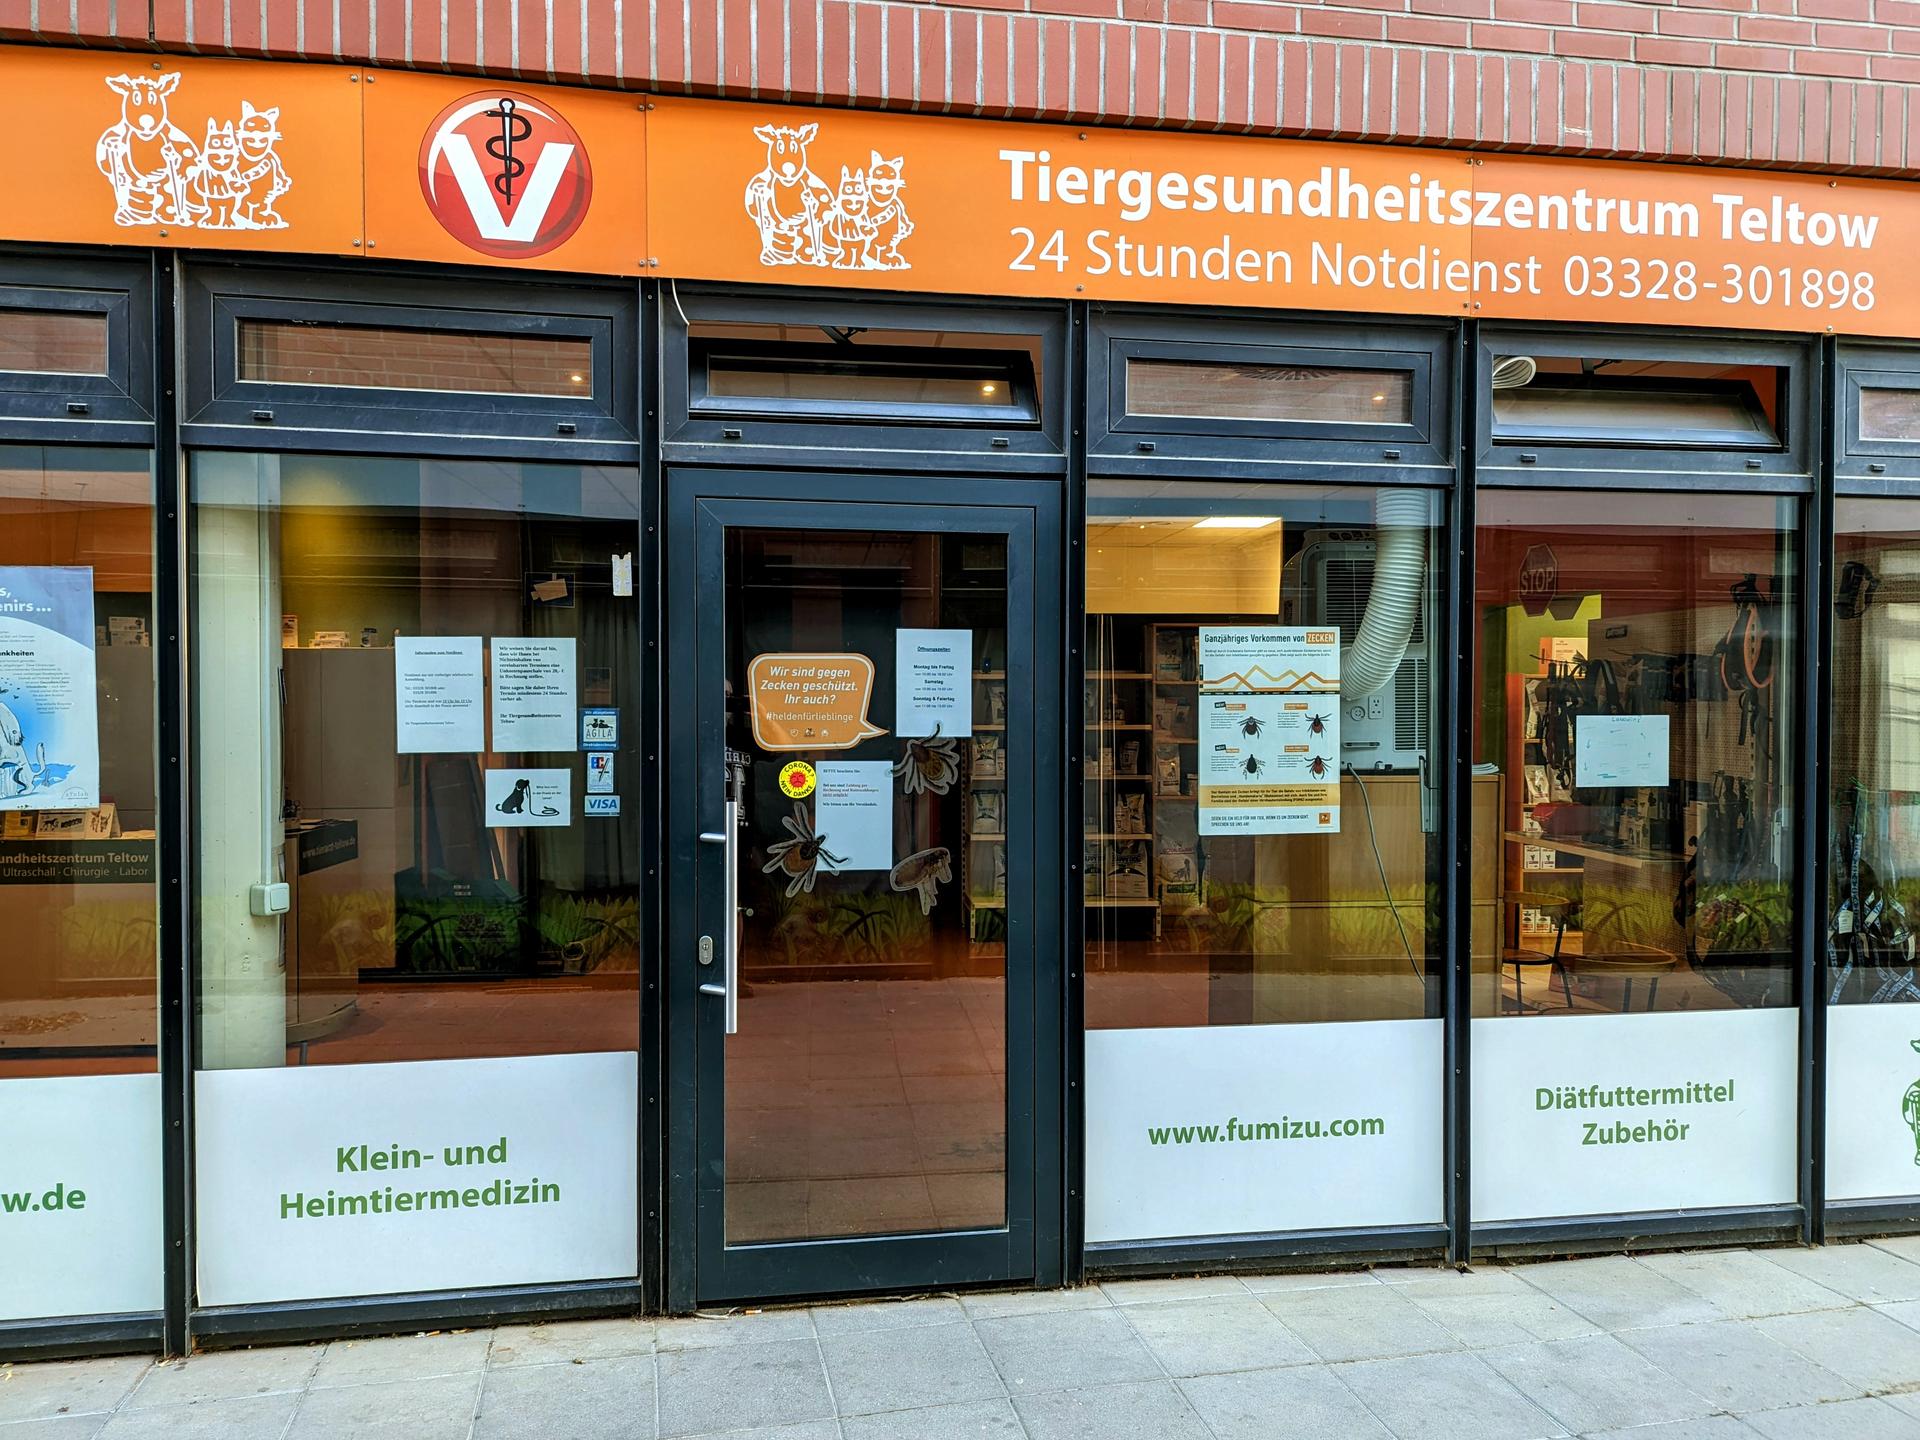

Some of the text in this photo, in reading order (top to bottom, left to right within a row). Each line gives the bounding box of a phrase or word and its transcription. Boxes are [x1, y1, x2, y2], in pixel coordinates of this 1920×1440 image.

[999, 149, 1879, 249] Tiergesundheitszentrum Teltow
[1008, 226, 1876, 312] 24 Stunden Notdienst 03328-301898
[1520, 565, 1554, 593] STOP
[1204, 634, 1248, 646] Ganzjähriges
[1251, 634, 1291, 643] Vorkommen
[1307, 634, 1334, 643] ZECKEN
[0, 649, 35, 657] nkheiten
[770, 666, 850, 679] Wir sind gegen
[760, 680, 858, 692] Zecken geschützt.
[784, 694, 836, 704] Ihr auch?
[766, 711, 854, 722] #heldenfürlieblinge
[586, 728, 612, 738] AGILA
[780, 780, 813, 797] NEIN DANKE
[589, 799, 618, 809] VISA
[107, 851, 149, 864] Teltow
[2, 866, 56, 878] Ultraschall
[63, 865, 110, 879] Chirurgie
[119, 865, 149, 877] Labor
[1534, 1079, 1735, 1111] Diätfuttermittel
[1147, 1113, 1385, 1146] www.fumizu.com
[1581, 1118, 1690, 1146] Zubehör
[336, 1137, 509, 1173] Klein- und
[1, 1182, 87, 1213] w.de
[279, 1177, 561, 1219] Heimtiermedizin
